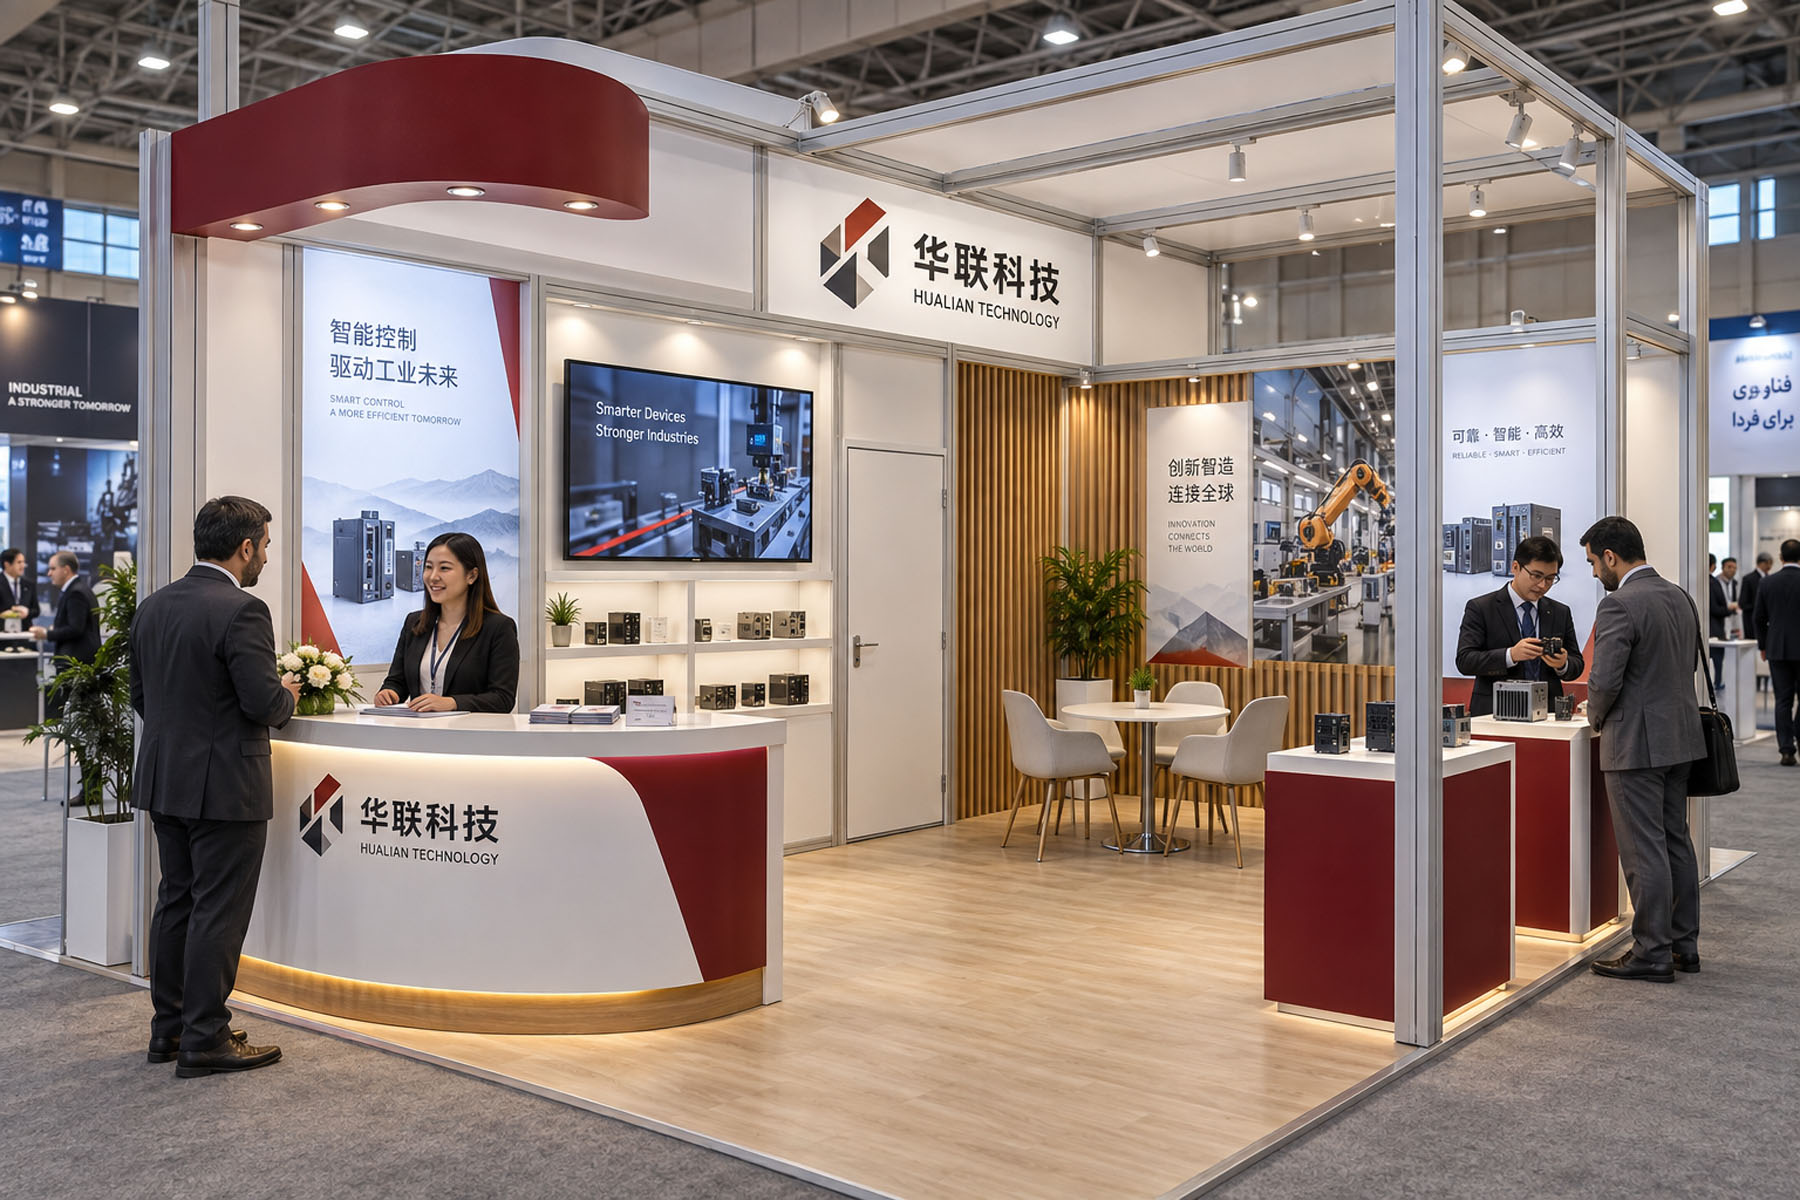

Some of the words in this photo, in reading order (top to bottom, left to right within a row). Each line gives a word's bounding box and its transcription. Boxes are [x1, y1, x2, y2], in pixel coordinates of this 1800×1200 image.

[913, 233, 1060, 305] 华联科技
[913, 289, 974, 313] HUALIAN
[977, 301, 1060, 329] TECHNOLOGY
[330, 318, 417, 352] 智能控制
[330, 353, 458, 388] 驱动工业未来
[8, 381, 83, 398] INDUSTRIAL
[8, 397, 16, 406] A
[18, 397, 71, 409] STRONGER
[72, 400, 131, 413] TOMORROW
[330, 394, 361, 405] SMART
[363, 396, 405, 409] CONTROL
[595, 401, 642, 419] Smarter
[644, 407, 686, 423] Devices
[330, 408, 337, 417] A
[338, 408, 365, 419] MORE
[366, 410, 409, 422] EFFICIENT
[411, 414, 462, 426] TOMORROW
[1732, 409, 1760, 432] فردا
[1763, 409, 1794, 430] برای
[595, 424, 644, 443] Stronger
[647, 428, 699, 445] Industries
[1493, 426, 1522, 442] 智能
[1534, 424, 1564, 440] 高效
[1493, 449, 1520, 458] SMART
[1527, 447, 1567, 457] EFFICIENT
[1168, 456, 1234, 477] 创新智造
[1168, 482, 1235, 504] 连接全球
[1167, 519, 1216, 529] INNOVATION
[1167, 532, 1211, 541] CONNECTS
[1168, 544, 1183, 553] THE
[360, 796, 499, 844] 华联科技
[360, 842, 409, 859] HUALIAN
[412, 847, 499, 866] TECHNOLOGY
